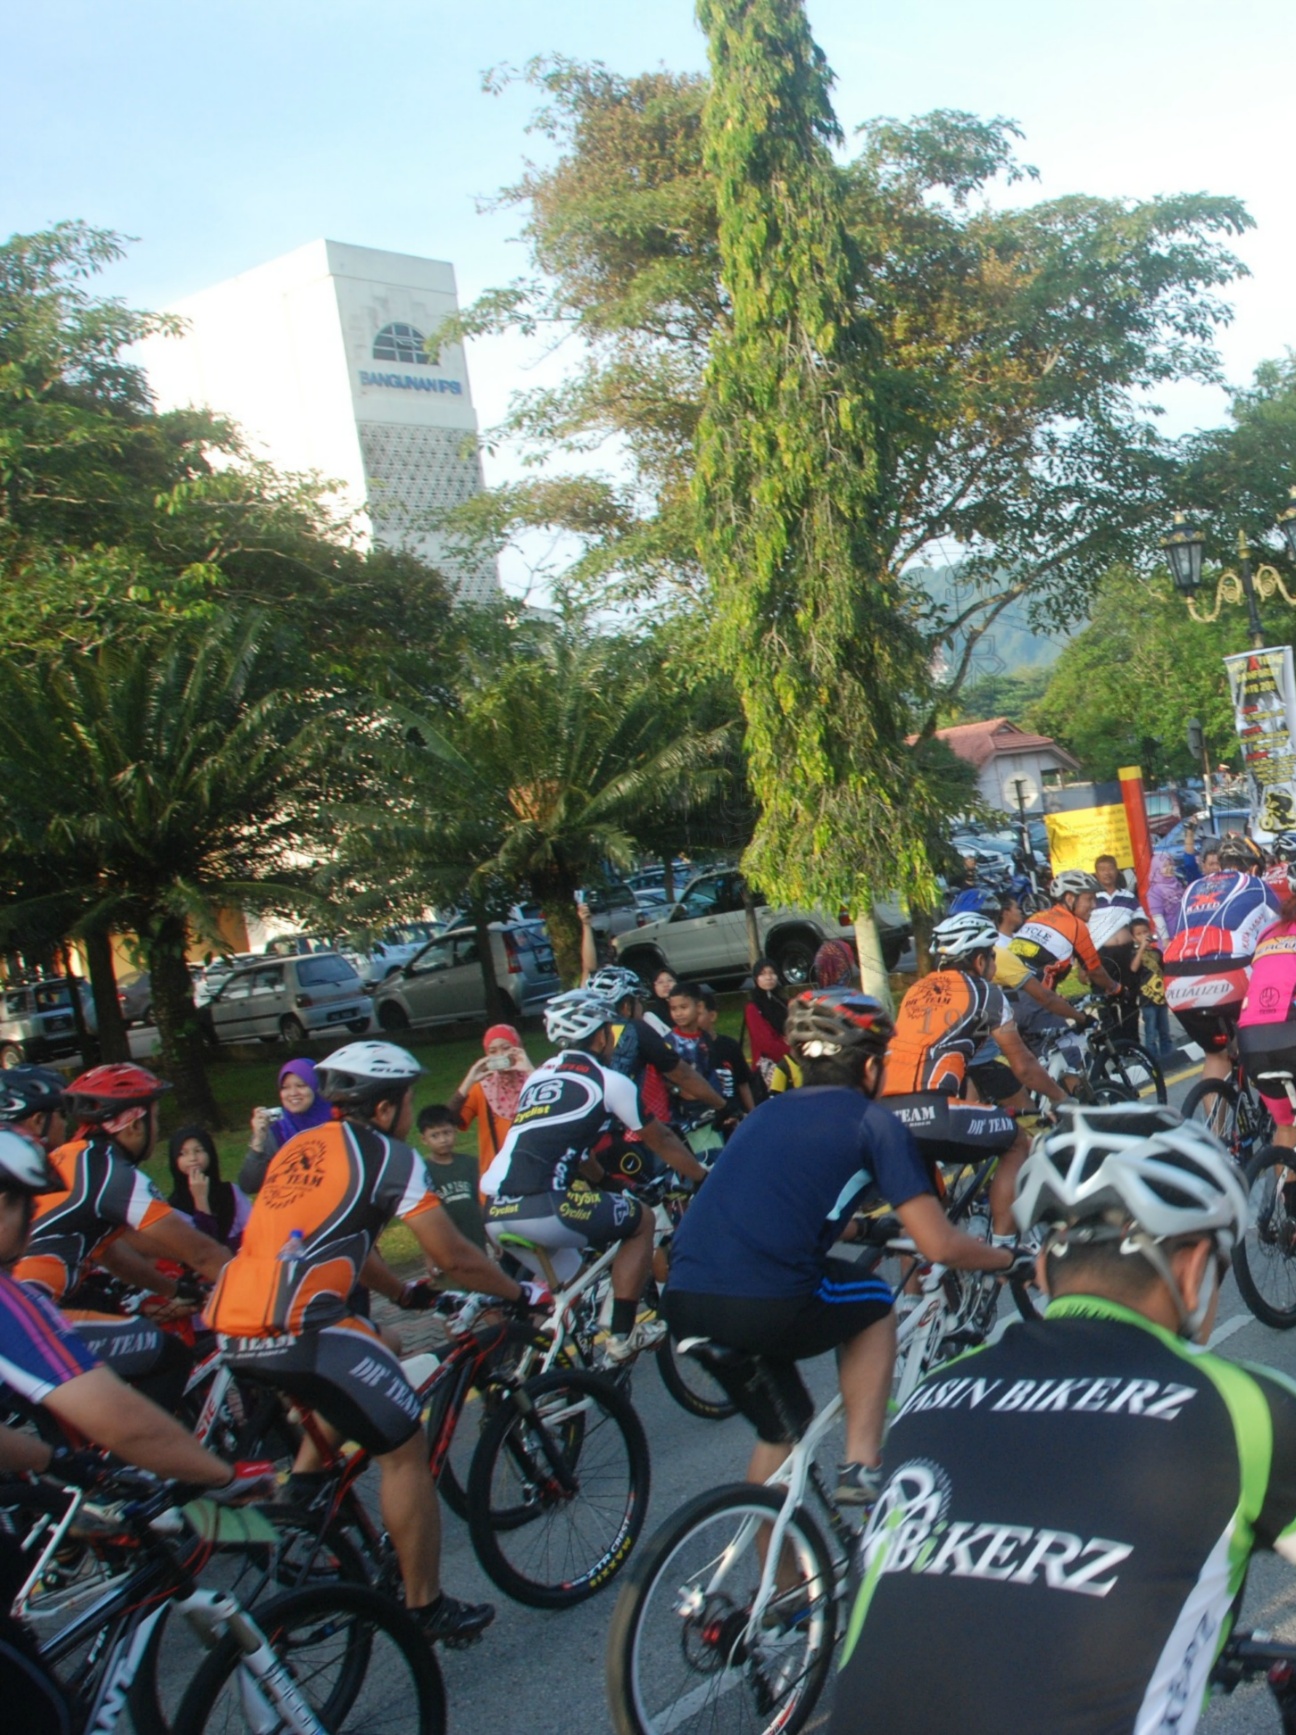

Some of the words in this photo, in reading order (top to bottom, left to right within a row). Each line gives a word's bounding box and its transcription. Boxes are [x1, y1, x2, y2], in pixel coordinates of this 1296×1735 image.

[358, 370, 438, 393] BANGUNAN
[988, 1117, 1014, 1134] TEAM
[489, 1202, 520, 1218] Cyclist
[560, 1202, 592, 1220] Cyclist
[109, 1330, 158, 1357] TEAM
[384, 1376, 422, 1421] TEAM
[990, 1377, 1199, 1422] BIKERZ
